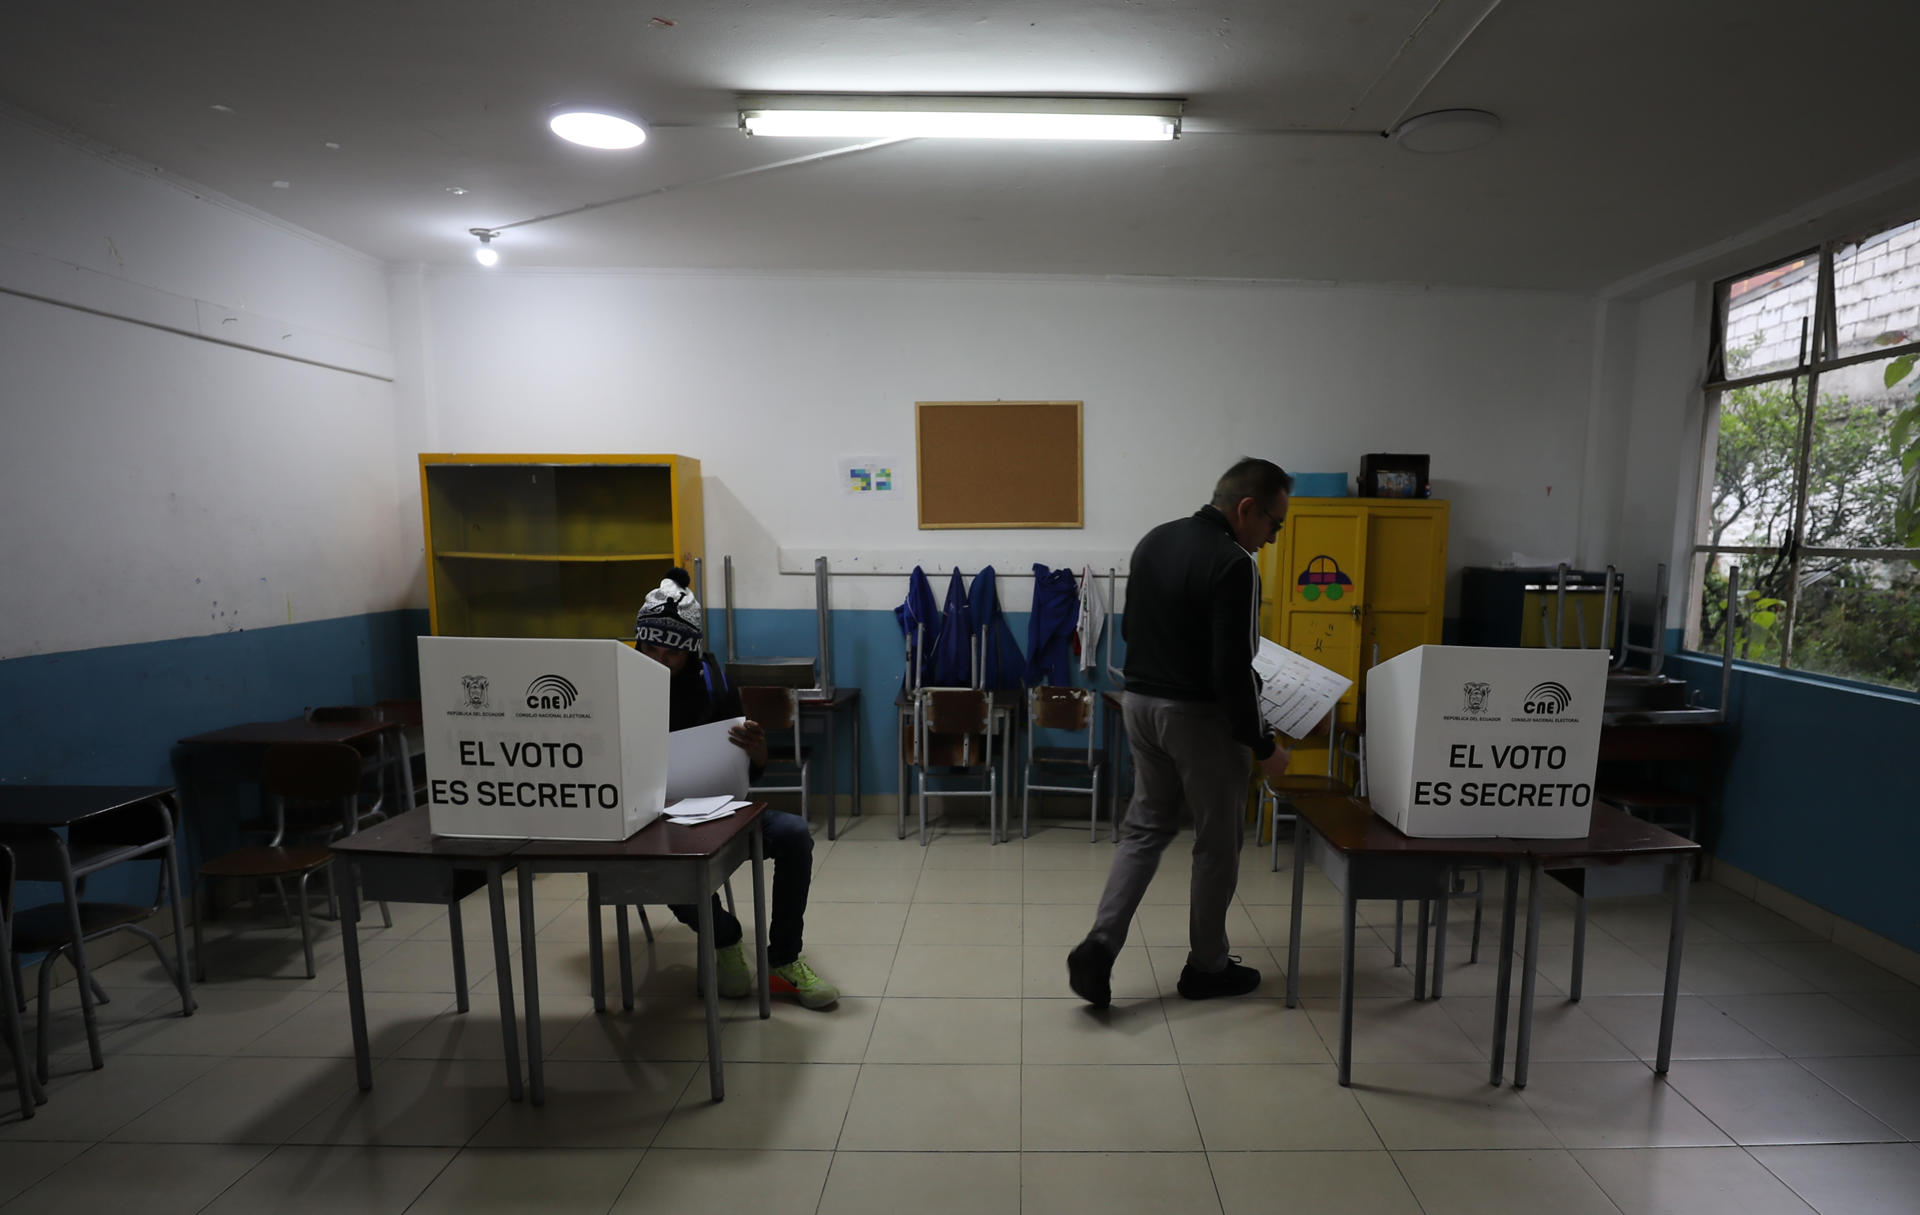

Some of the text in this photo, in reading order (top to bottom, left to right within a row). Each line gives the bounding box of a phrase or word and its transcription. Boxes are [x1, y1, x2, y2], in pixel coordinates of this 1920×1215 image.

[460, 741, 583, 768] EL VOTO
[1450, 744, 1566, 769] EL VOTO
[432, 780, 618, 809] ES SECRETO
[1415, 782, 1590, 807] ES SECRETO
